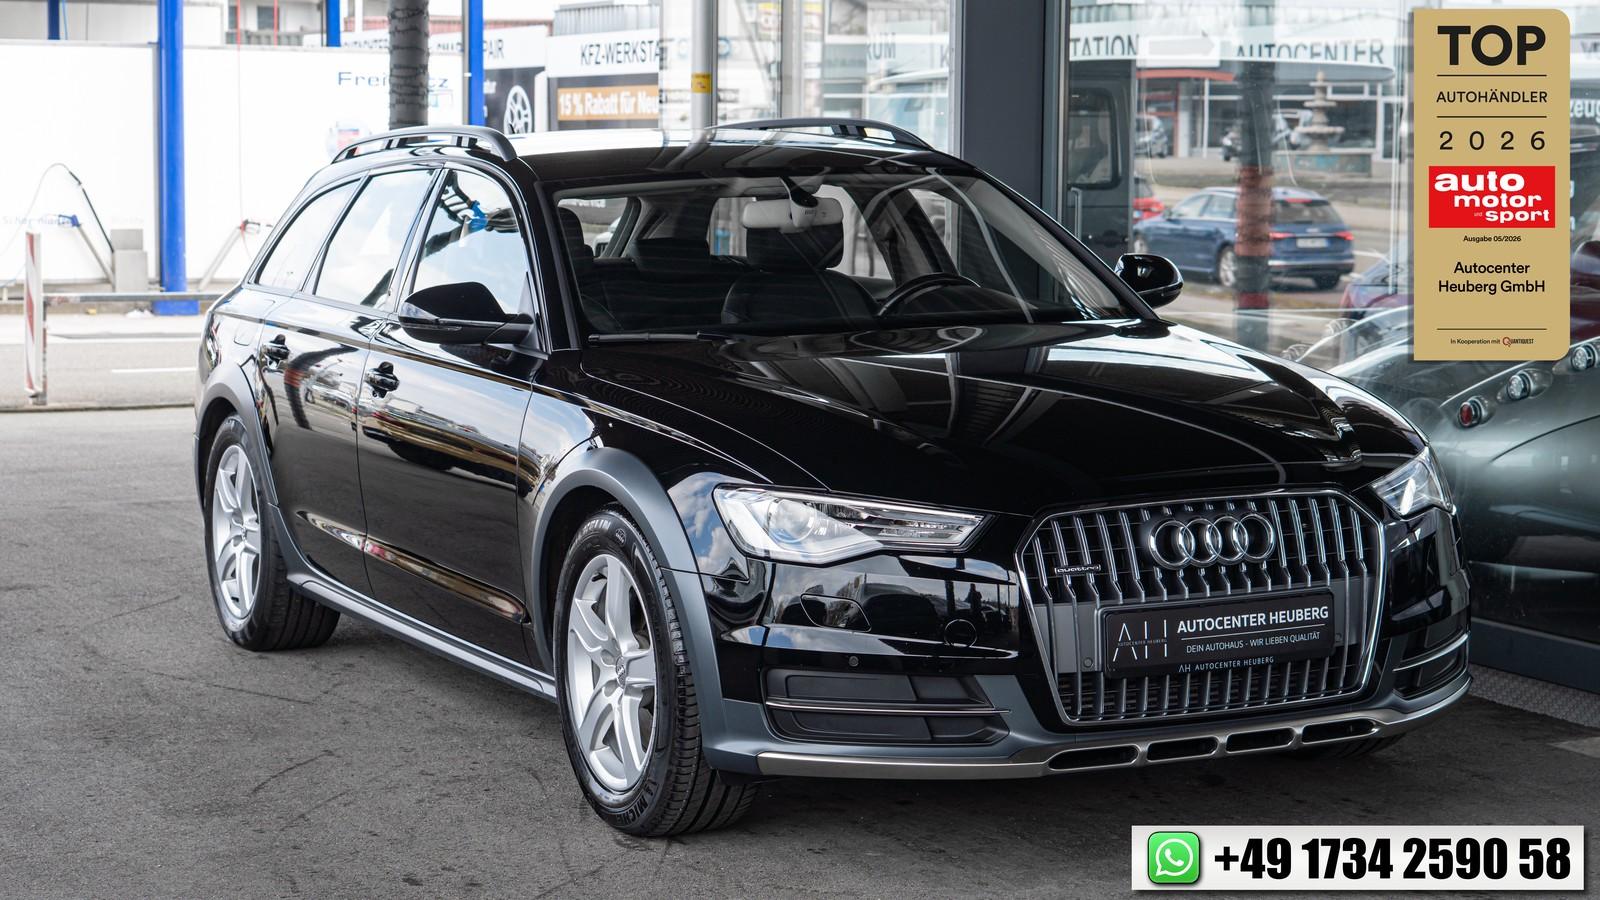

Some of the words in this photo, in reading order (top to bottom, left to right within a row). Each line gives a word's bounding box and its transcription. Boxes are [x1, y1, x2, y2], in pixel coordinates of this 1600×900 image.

[1236, 39, 1385, 64] AUTOCENTER
[559, 92, 571, 116] 15
[572, 92, 583, 116] %
[584, 91, 619, 115] Rabatt
[1177, 611, 1267, 633] AUTOCENTER
[1269, 606, 1329, 625] HEUBERG
[1186, 644, 1205, 654] DEIN
[1205, 640, 1244, 652] AUTOHAUS
[1249, 638, 1264, 647] WIR
[1265, 635, 1289, 646] LIEBEN
[1289, 631, 1321, 644] QUALITÄT
[1195, 660, 1241, 671] AUTOCENTER
[1243, 656, 1275, 665] HEUBERG
